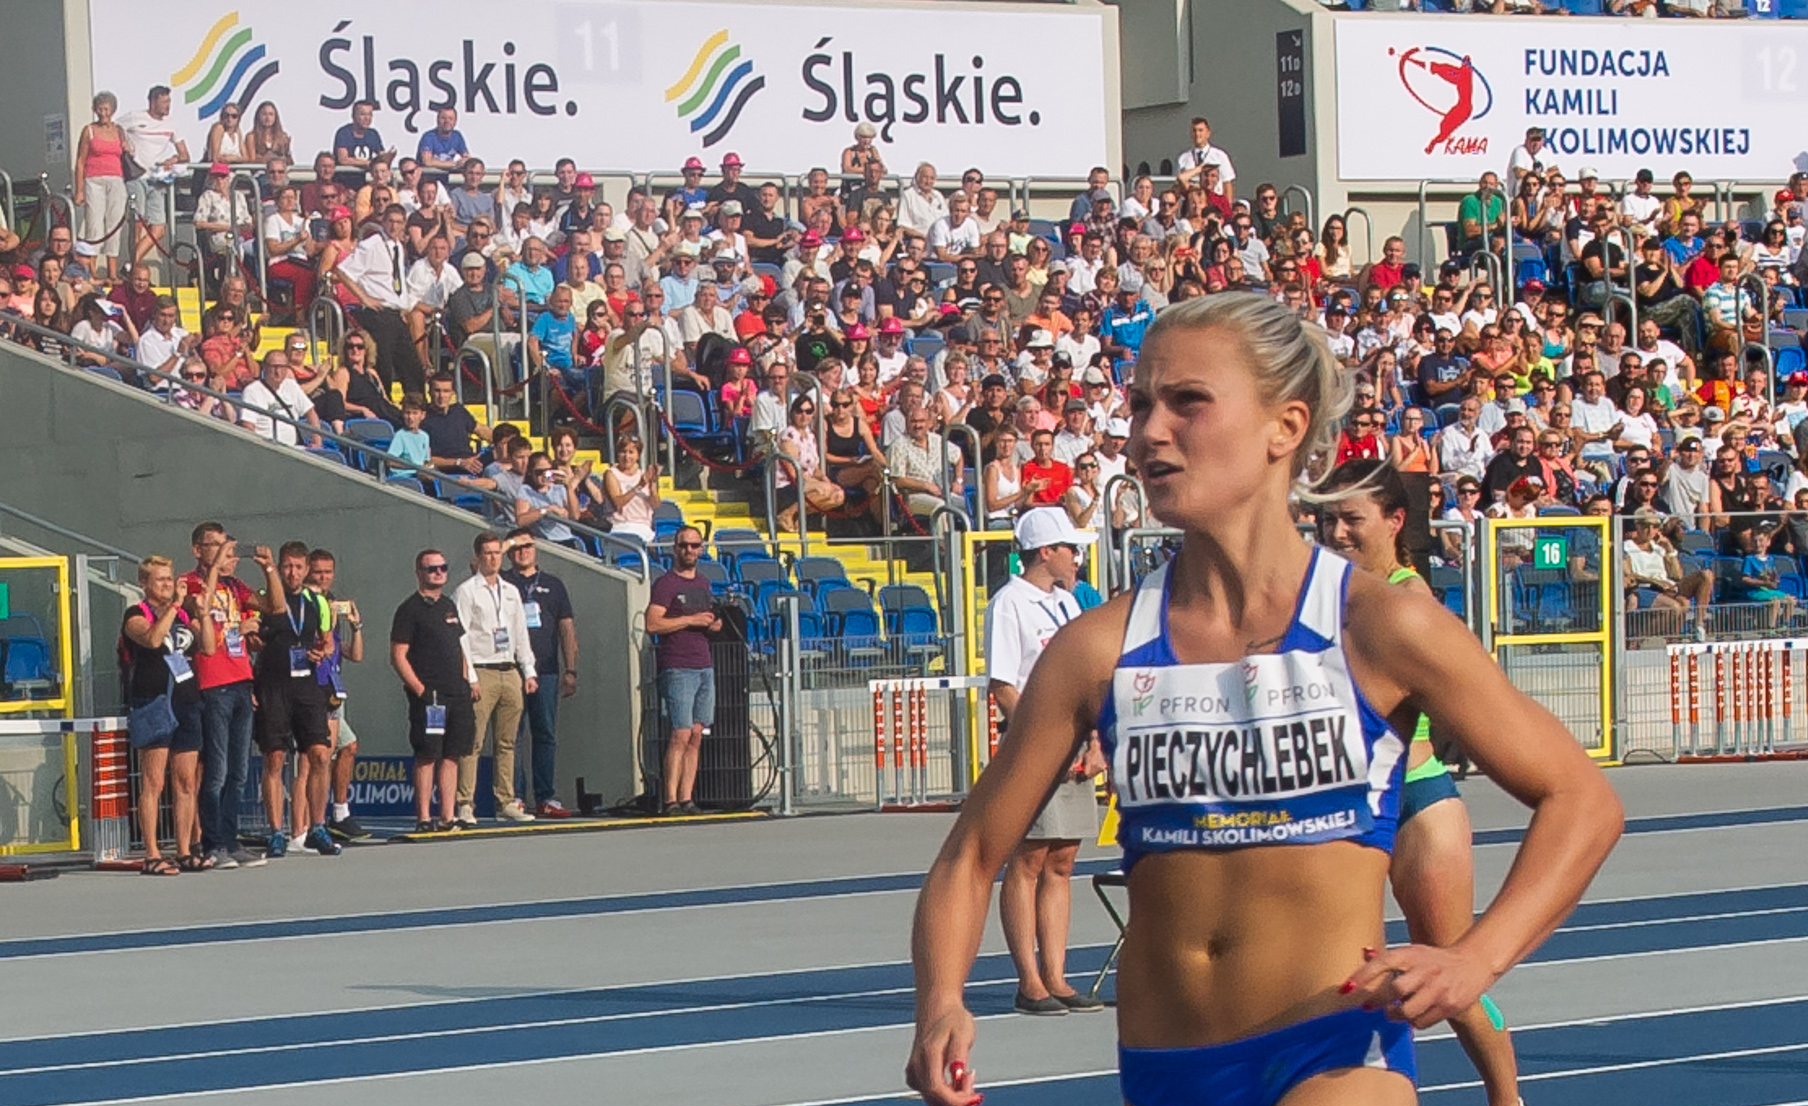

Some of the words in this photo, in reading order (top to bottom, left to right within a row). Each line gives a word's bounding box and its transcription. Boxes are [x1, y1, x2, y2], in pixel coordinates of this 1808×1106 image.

[317, 20, 578, 133] Śląskie.
[1524, 48, 1670, 77] FUNDACJA
[1755, 45, 1798, 93] 12
[801, 37, 1042, 144] Śląskie.
[1524, 88, 1618, 116] KAMILI
[1541, 127, 1751, 155] KOLIMOWSKIEJ
[1542, 542, 1561, 565] 16
[1160, 695, 1230, 715] PFRON
[1267, 682, 1336, 706] PFRON
[1126, 714, 1356, 801] PIECZYCHLEBEK
[1142, 827, 1198, 845] KAMILI
[1202, 808, 1356, 845] SKOLIMOWSKIEJ
